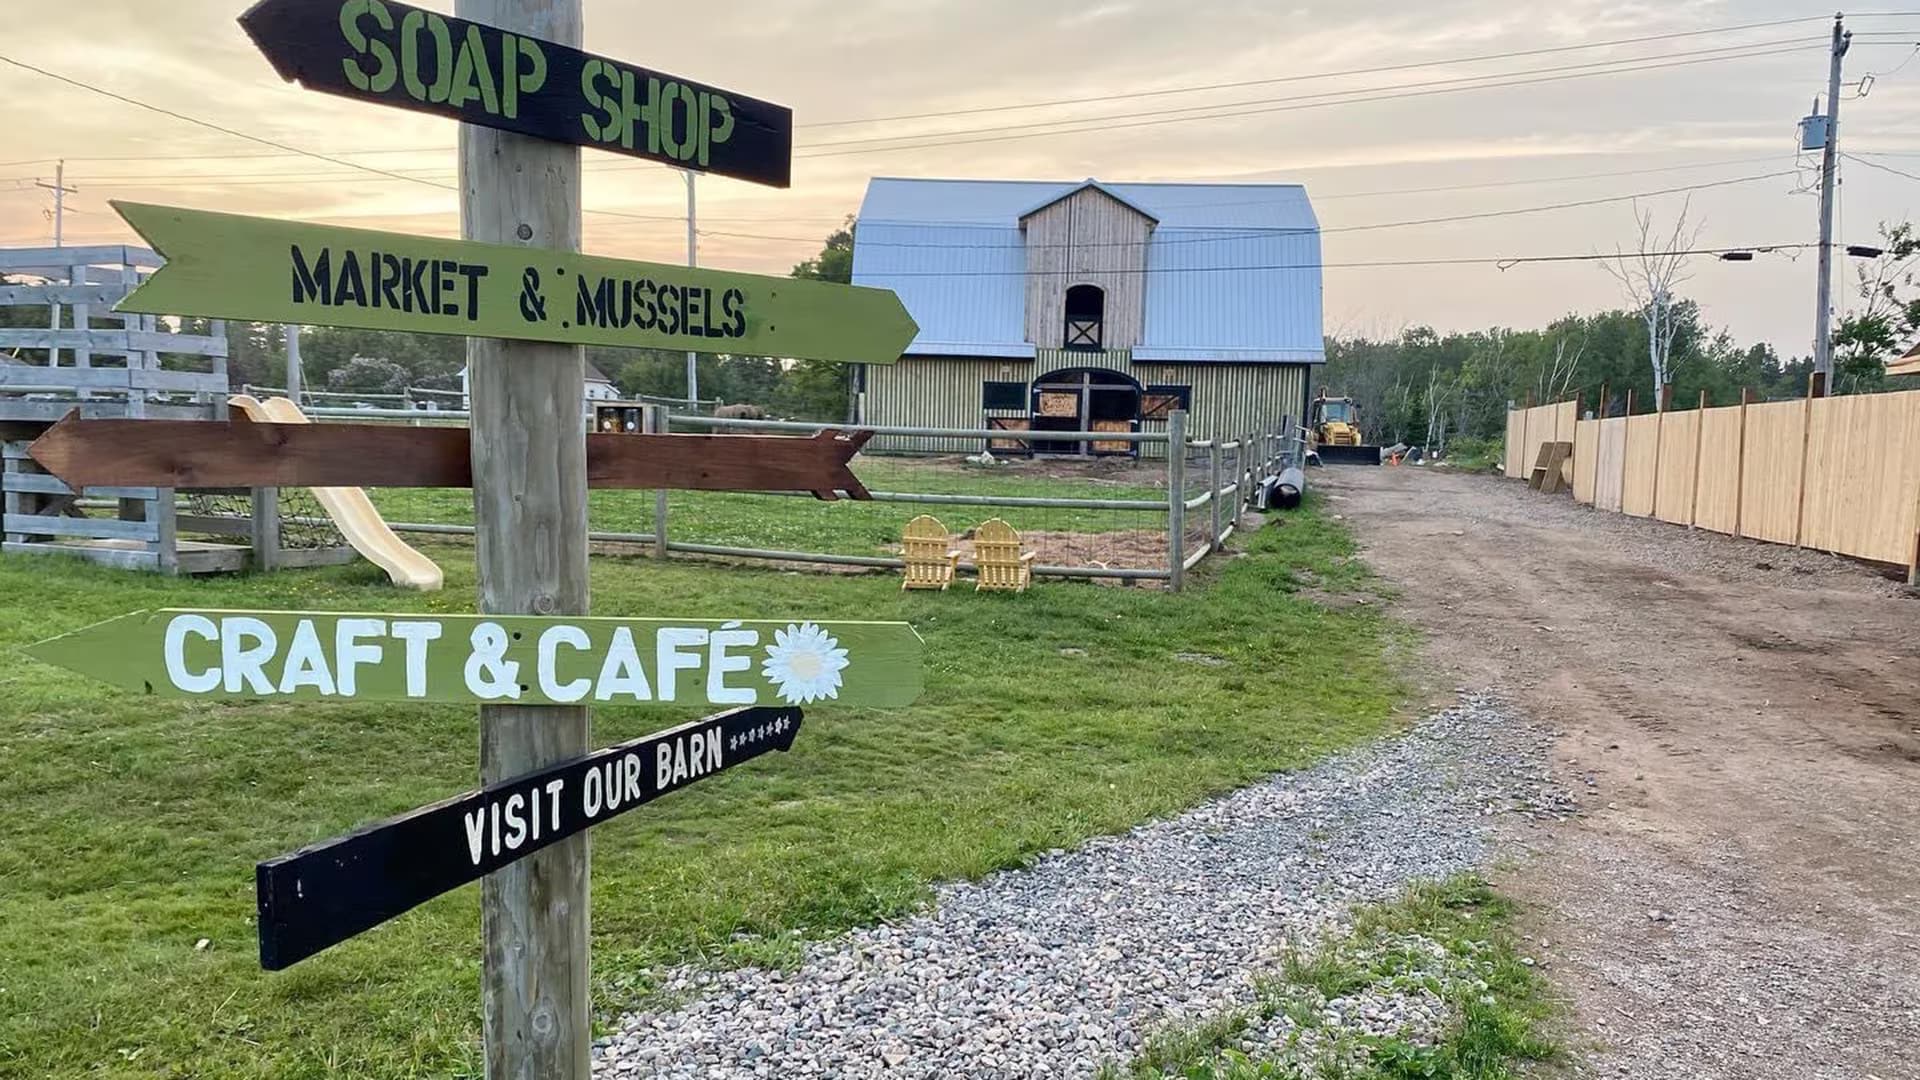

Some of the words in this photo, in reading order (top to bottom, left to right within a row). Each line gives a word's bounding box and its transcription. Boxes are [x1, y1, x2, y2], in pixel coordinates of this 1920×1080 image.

[339, 0, 547, 119] SOAP
[581, 59, 735, 167] SHOP
[291, 244, 488, 321] MARKET
[520, 267, 547, 322] &
[577, 274, 746, 338] MUSSELS
[163, 614, 442, 697] CRAFT
[464, 622, 520, 700] &
[537, 620, 759, 704] CAFÉ
[465, 779, 564, 865] VISIT
[583, 753, 640, 818] OUR
[656, 726, 722, 789] BARN
